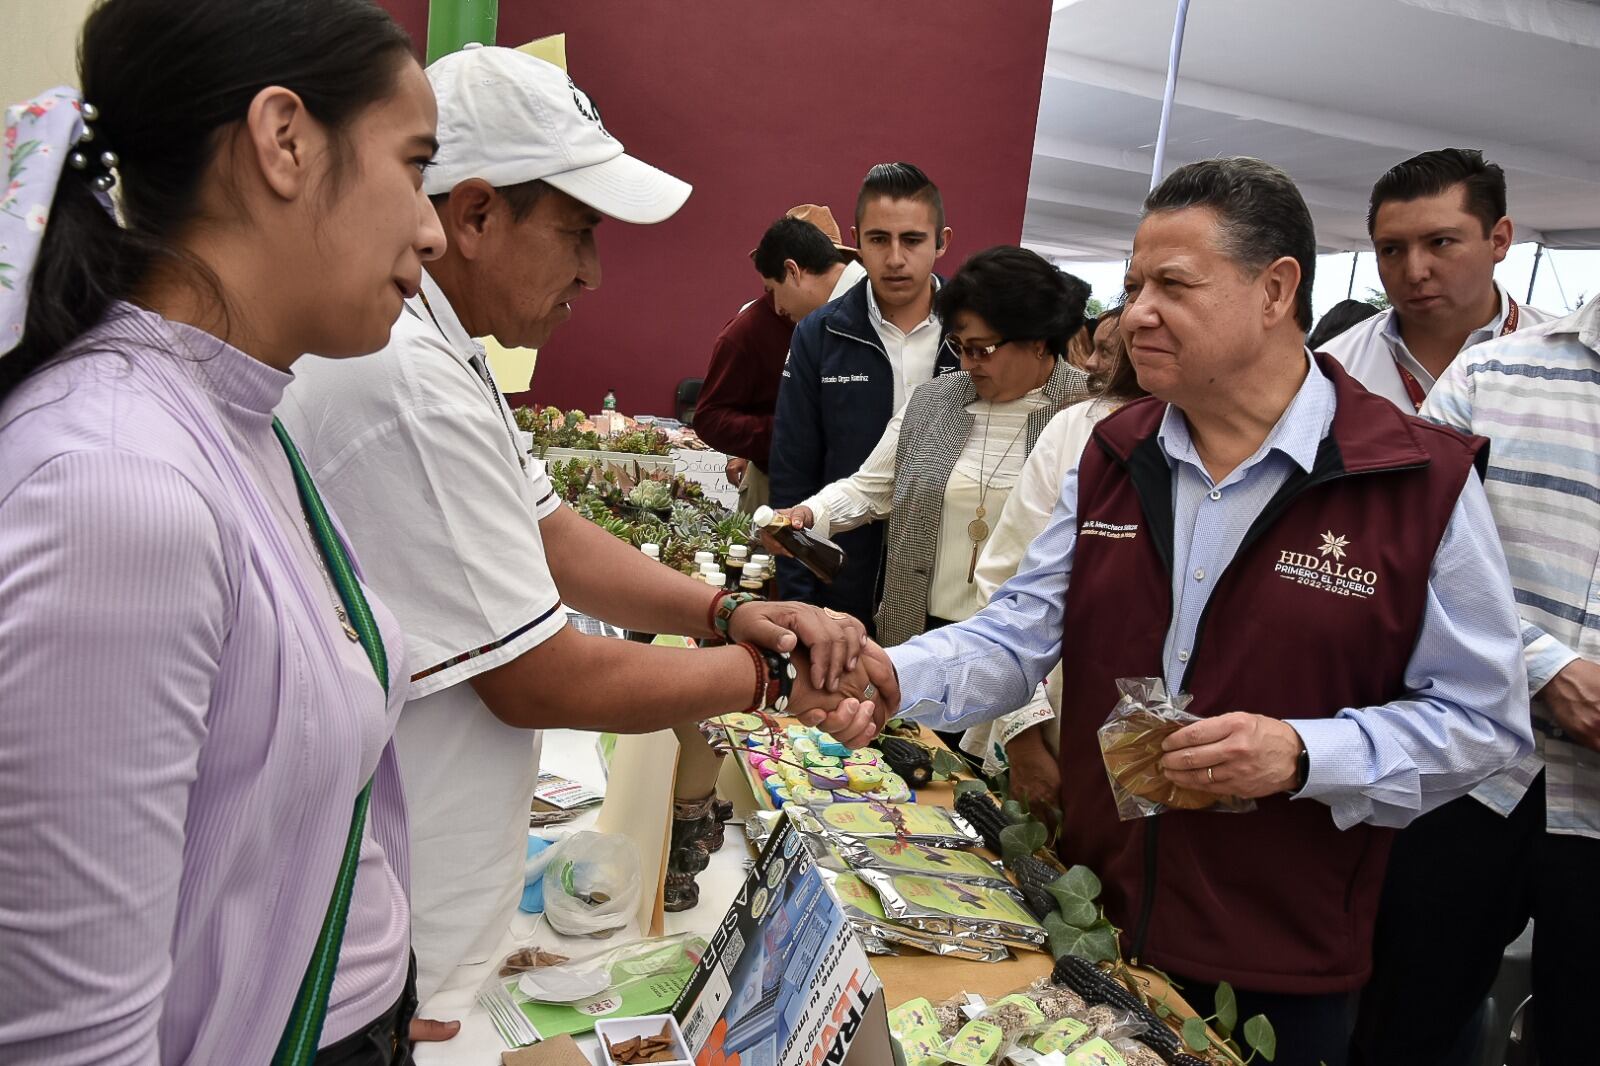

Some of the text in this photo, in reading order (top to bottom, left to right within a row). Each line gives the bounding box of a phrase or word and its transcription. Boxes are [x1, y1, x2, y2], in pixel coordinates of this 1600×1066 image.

[1274, 563, 1375, 595] PRIMERO EL PUEBLO
[1277, 550, 1378, 585] HIDALGO
[1296, 576, 1351, 596] 2022-2028
[703, 868, 761, 970] LASER
[809, 922, 848, 990] on estilo
[809, 990, 821, 1009] tu
[803, 982, 843, 1054] Liderazgo
